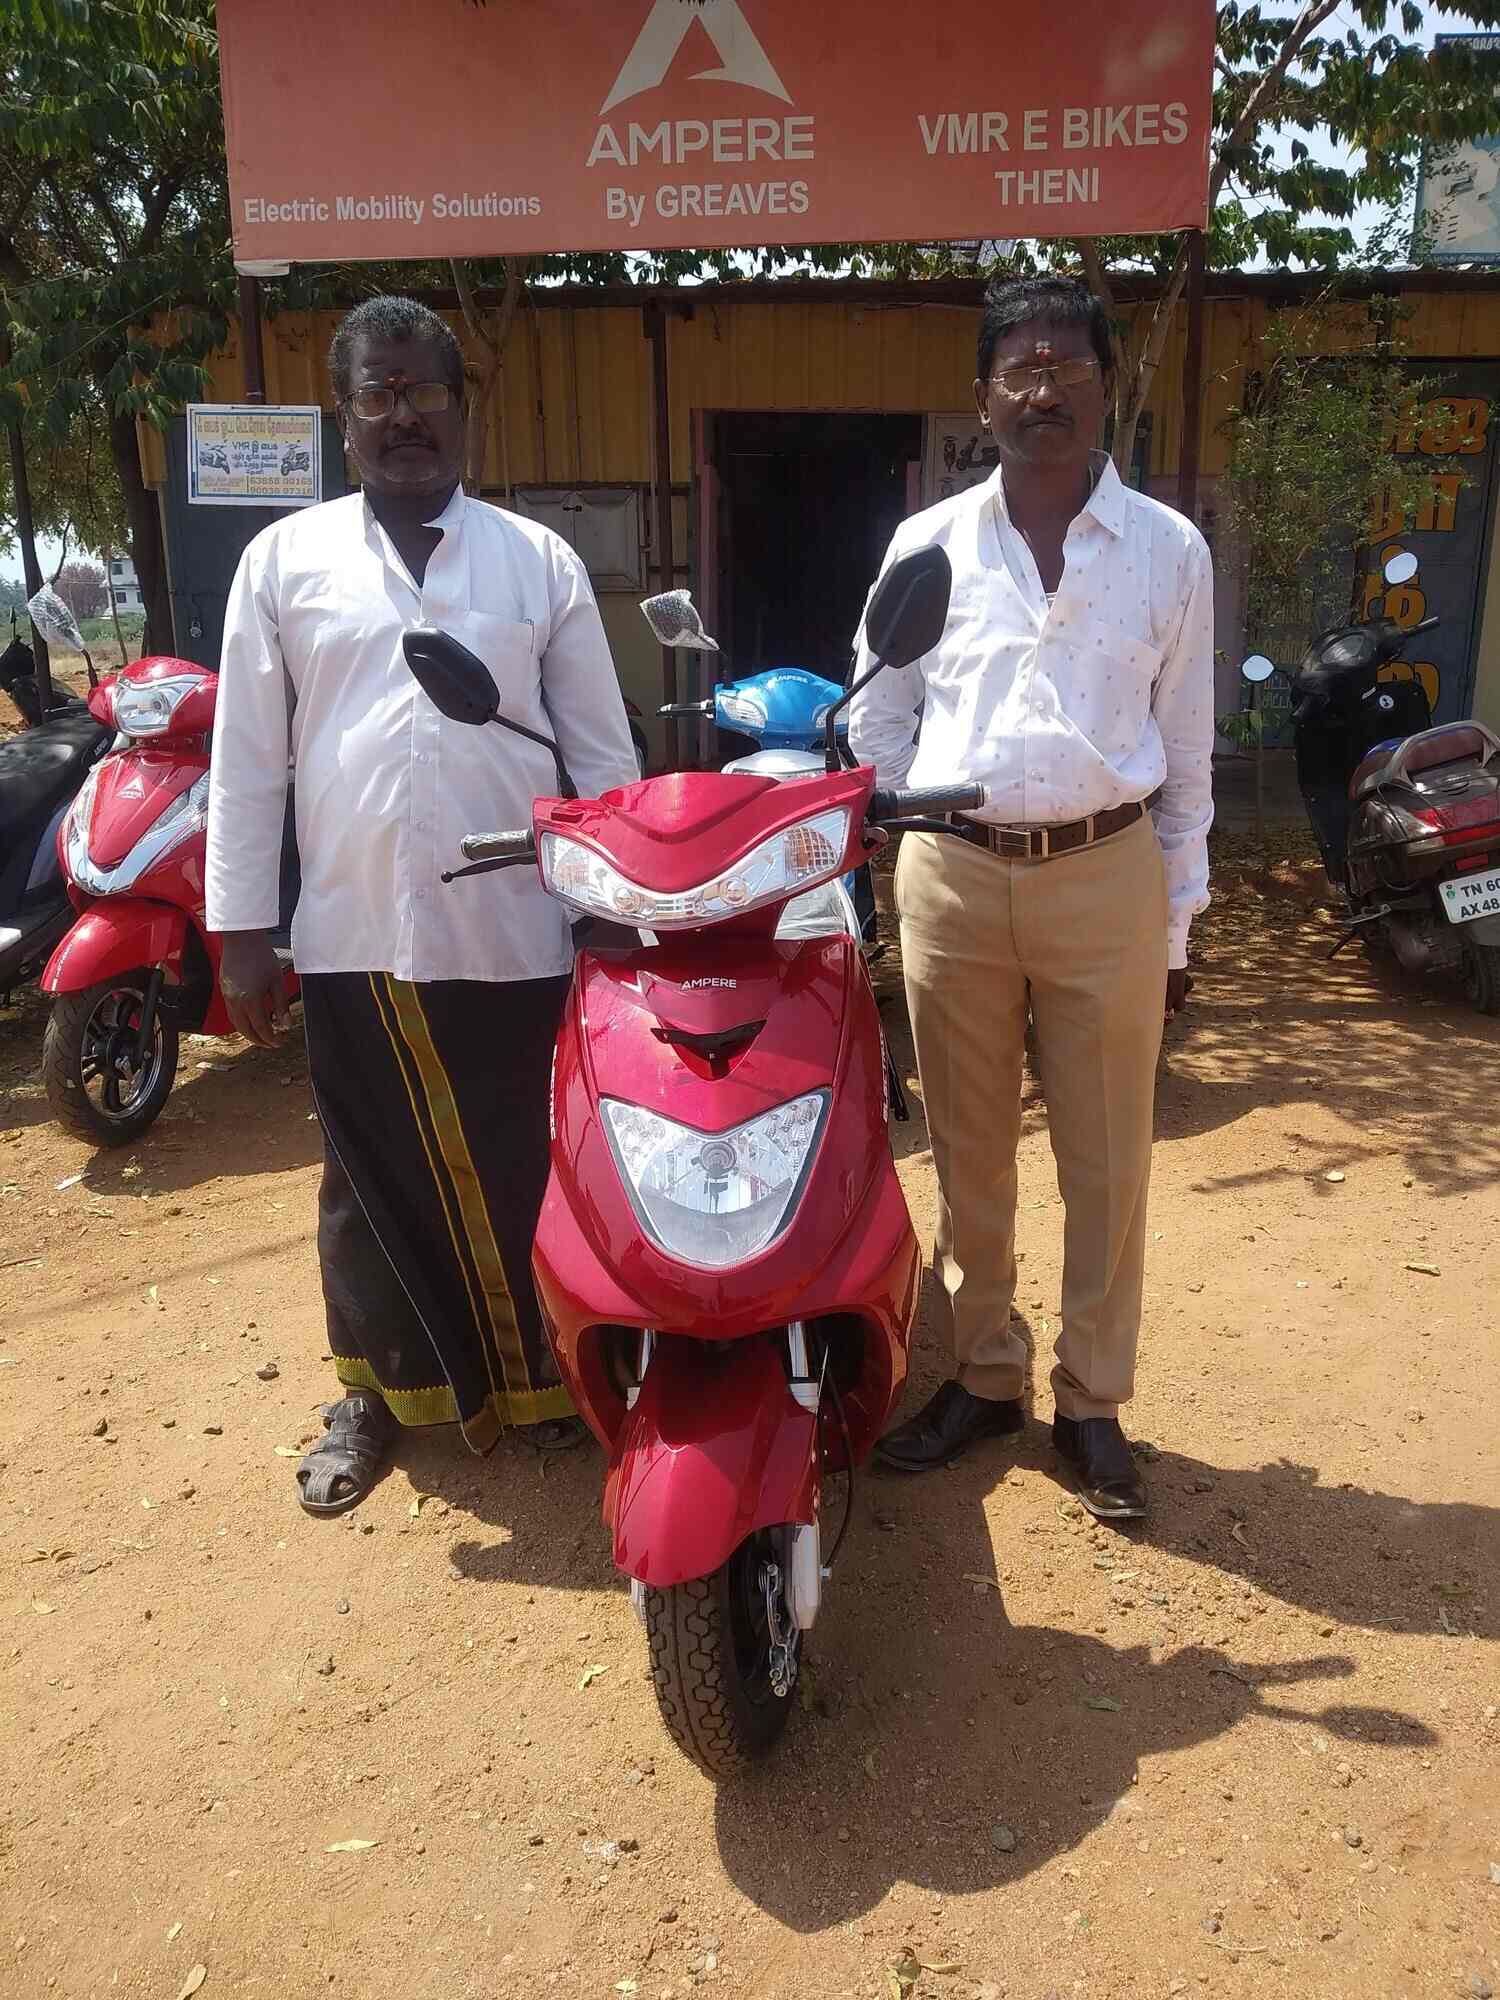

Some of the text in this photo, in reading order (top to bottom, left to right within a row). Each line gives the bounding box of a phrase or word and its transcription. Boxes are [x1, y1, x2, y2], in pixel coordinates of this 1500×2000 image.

[586, 116, 815, 168] AMPERE
[917, 102, 1189, 155] VMR E BIKES
[606, 180, 809, 227] By GREAVES
[995, 167, 1100, 205] THENI
[244, 193, 541, 225] Electric Mobility Solutions
[1461, 883, 1483, 897] TN
[681, 977, 737, 991] AMPERE
